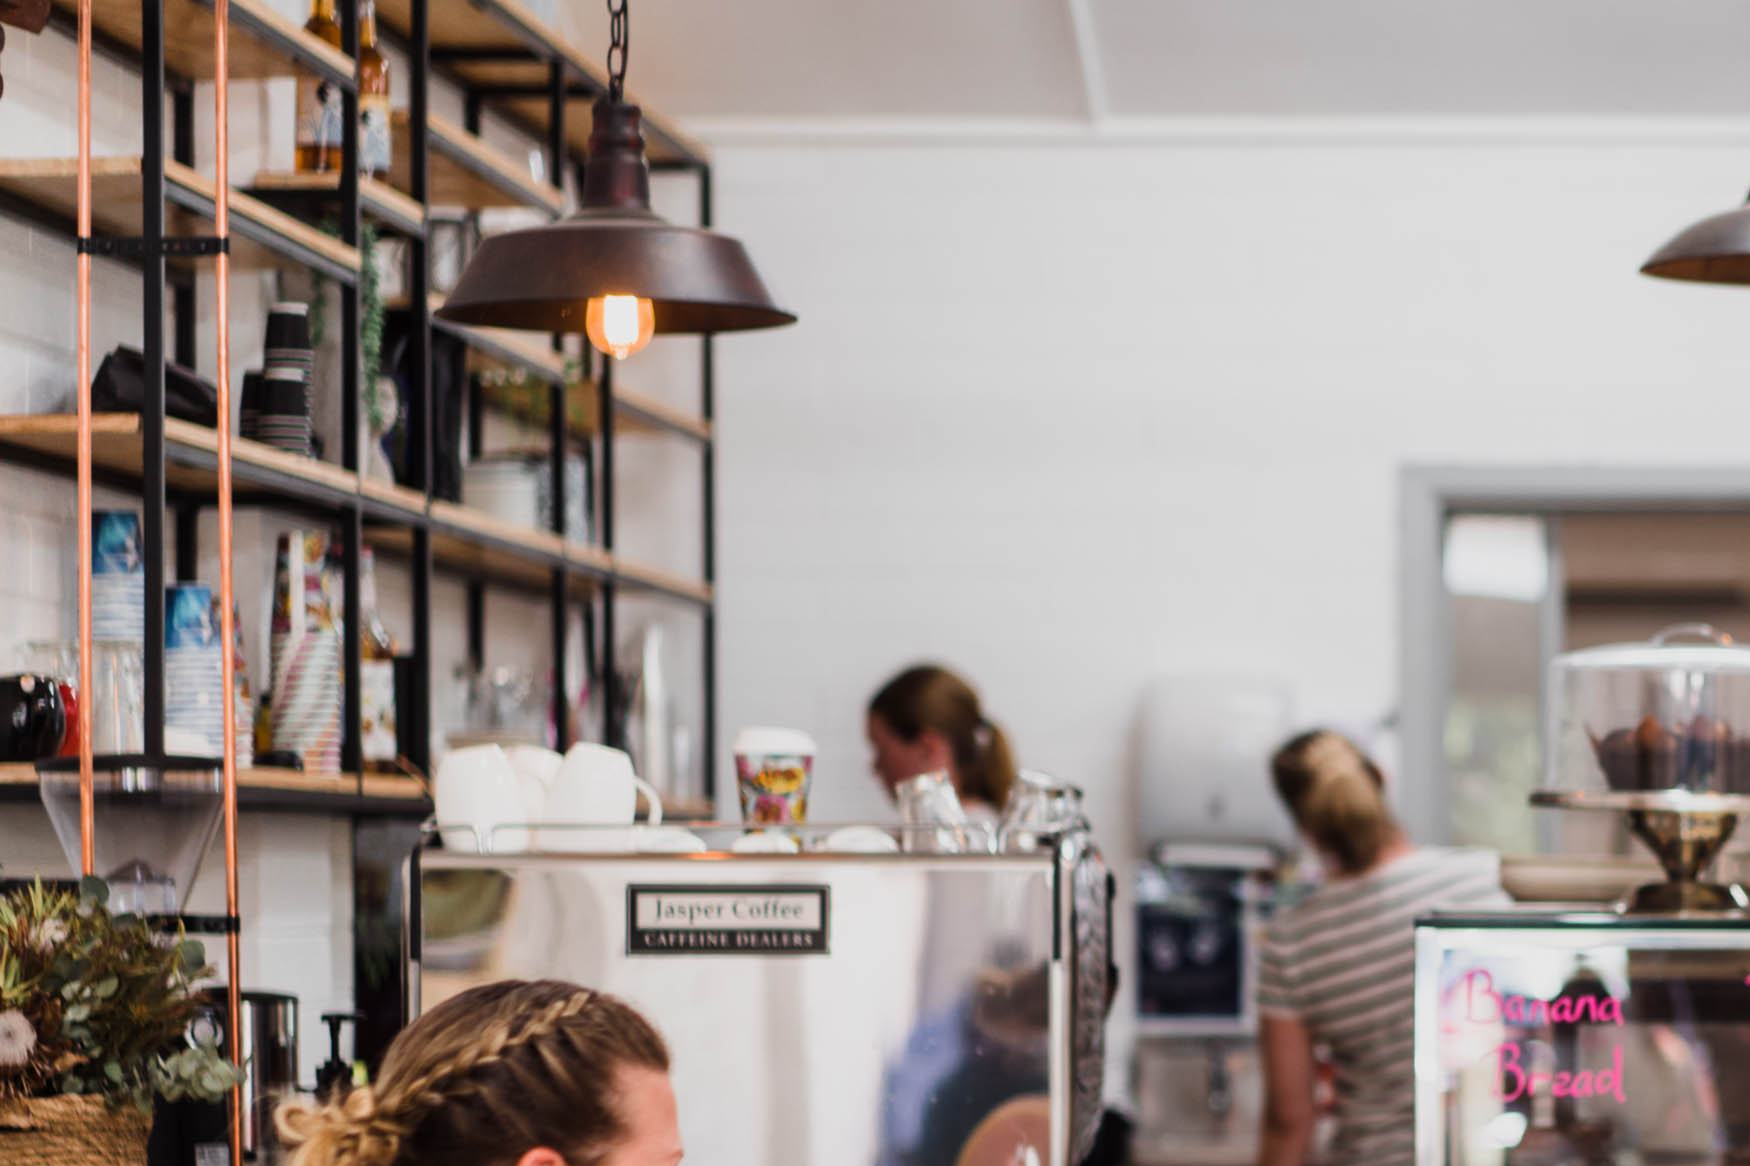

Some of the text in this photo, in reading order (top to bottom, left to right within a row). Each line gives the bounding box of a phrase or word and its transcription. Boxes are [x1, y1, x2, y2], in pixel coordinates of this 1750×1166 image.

[656, 898, 803, 926] Jasper Coffee
[644, 931, 814, 948] CAFFEINE DEALERS
[1448, 967, 1624, 1027] Banana
[1484, 1041, 1627, 1103] Bread
